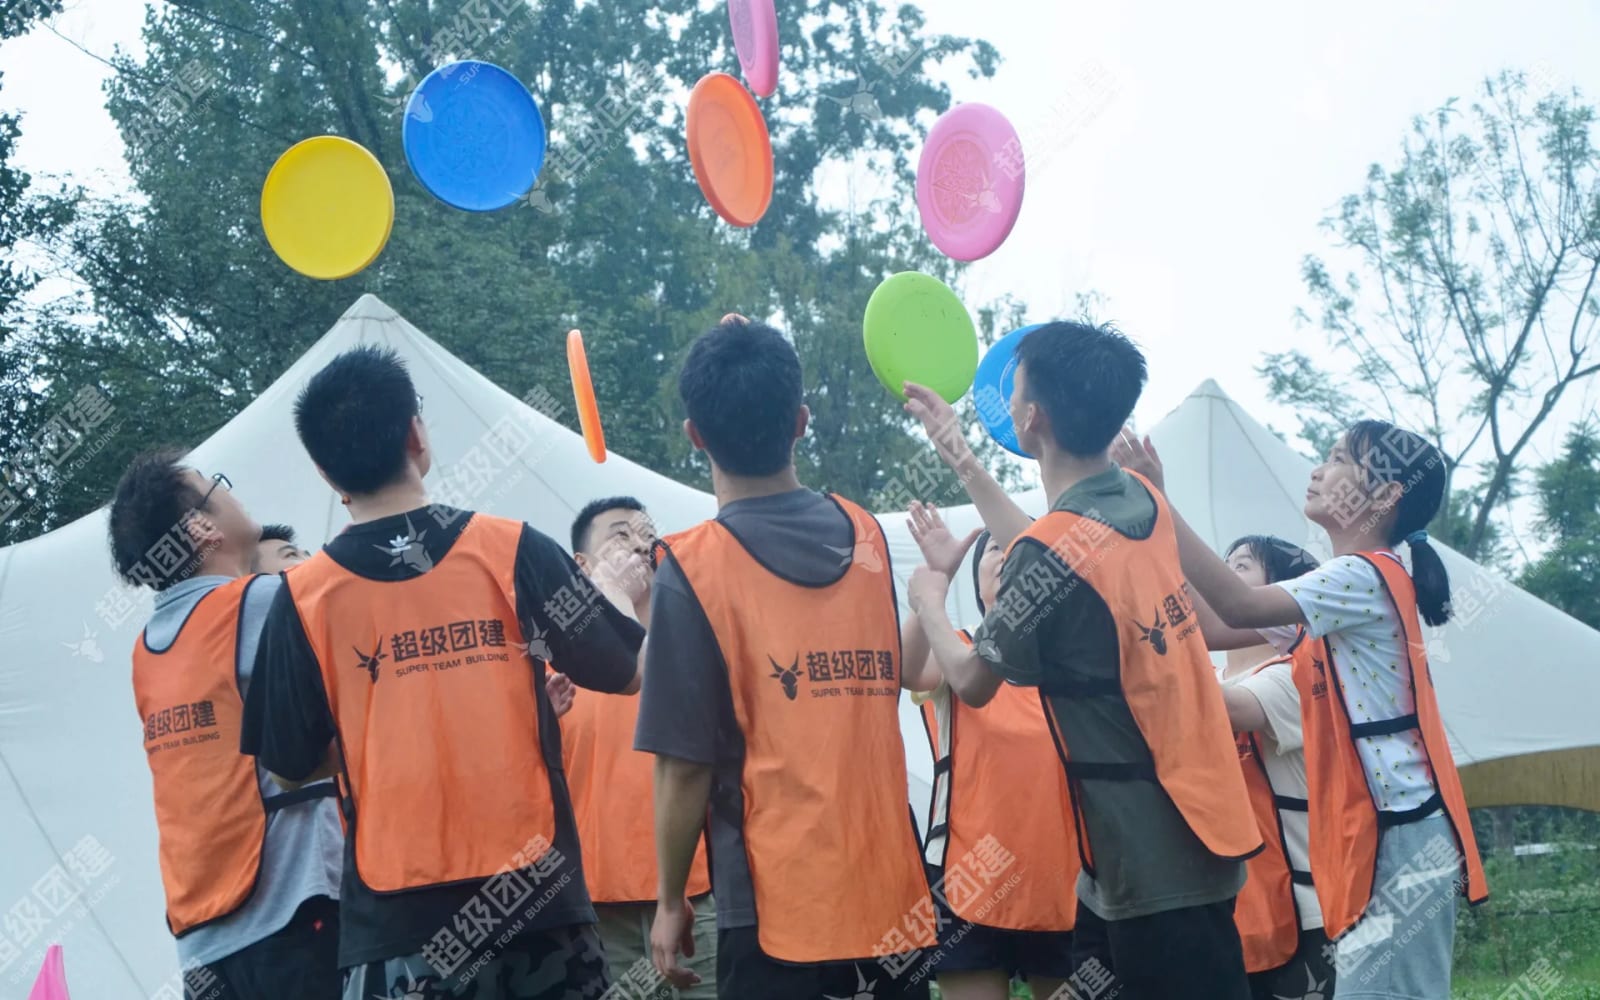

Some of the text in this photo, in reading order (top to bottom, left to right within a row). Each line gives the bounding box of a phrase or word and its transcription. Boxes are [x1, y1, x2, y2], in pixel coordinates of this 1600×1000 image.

[391, 619, 506, 663] 超级团建
[395, 653, 510, 678] SUPER TEAM BUILDING
[806, 650, 895, 682] 超级团建
[811, 687, 841, 698] SUPER
[844, 687, 865, 696] TEAM
